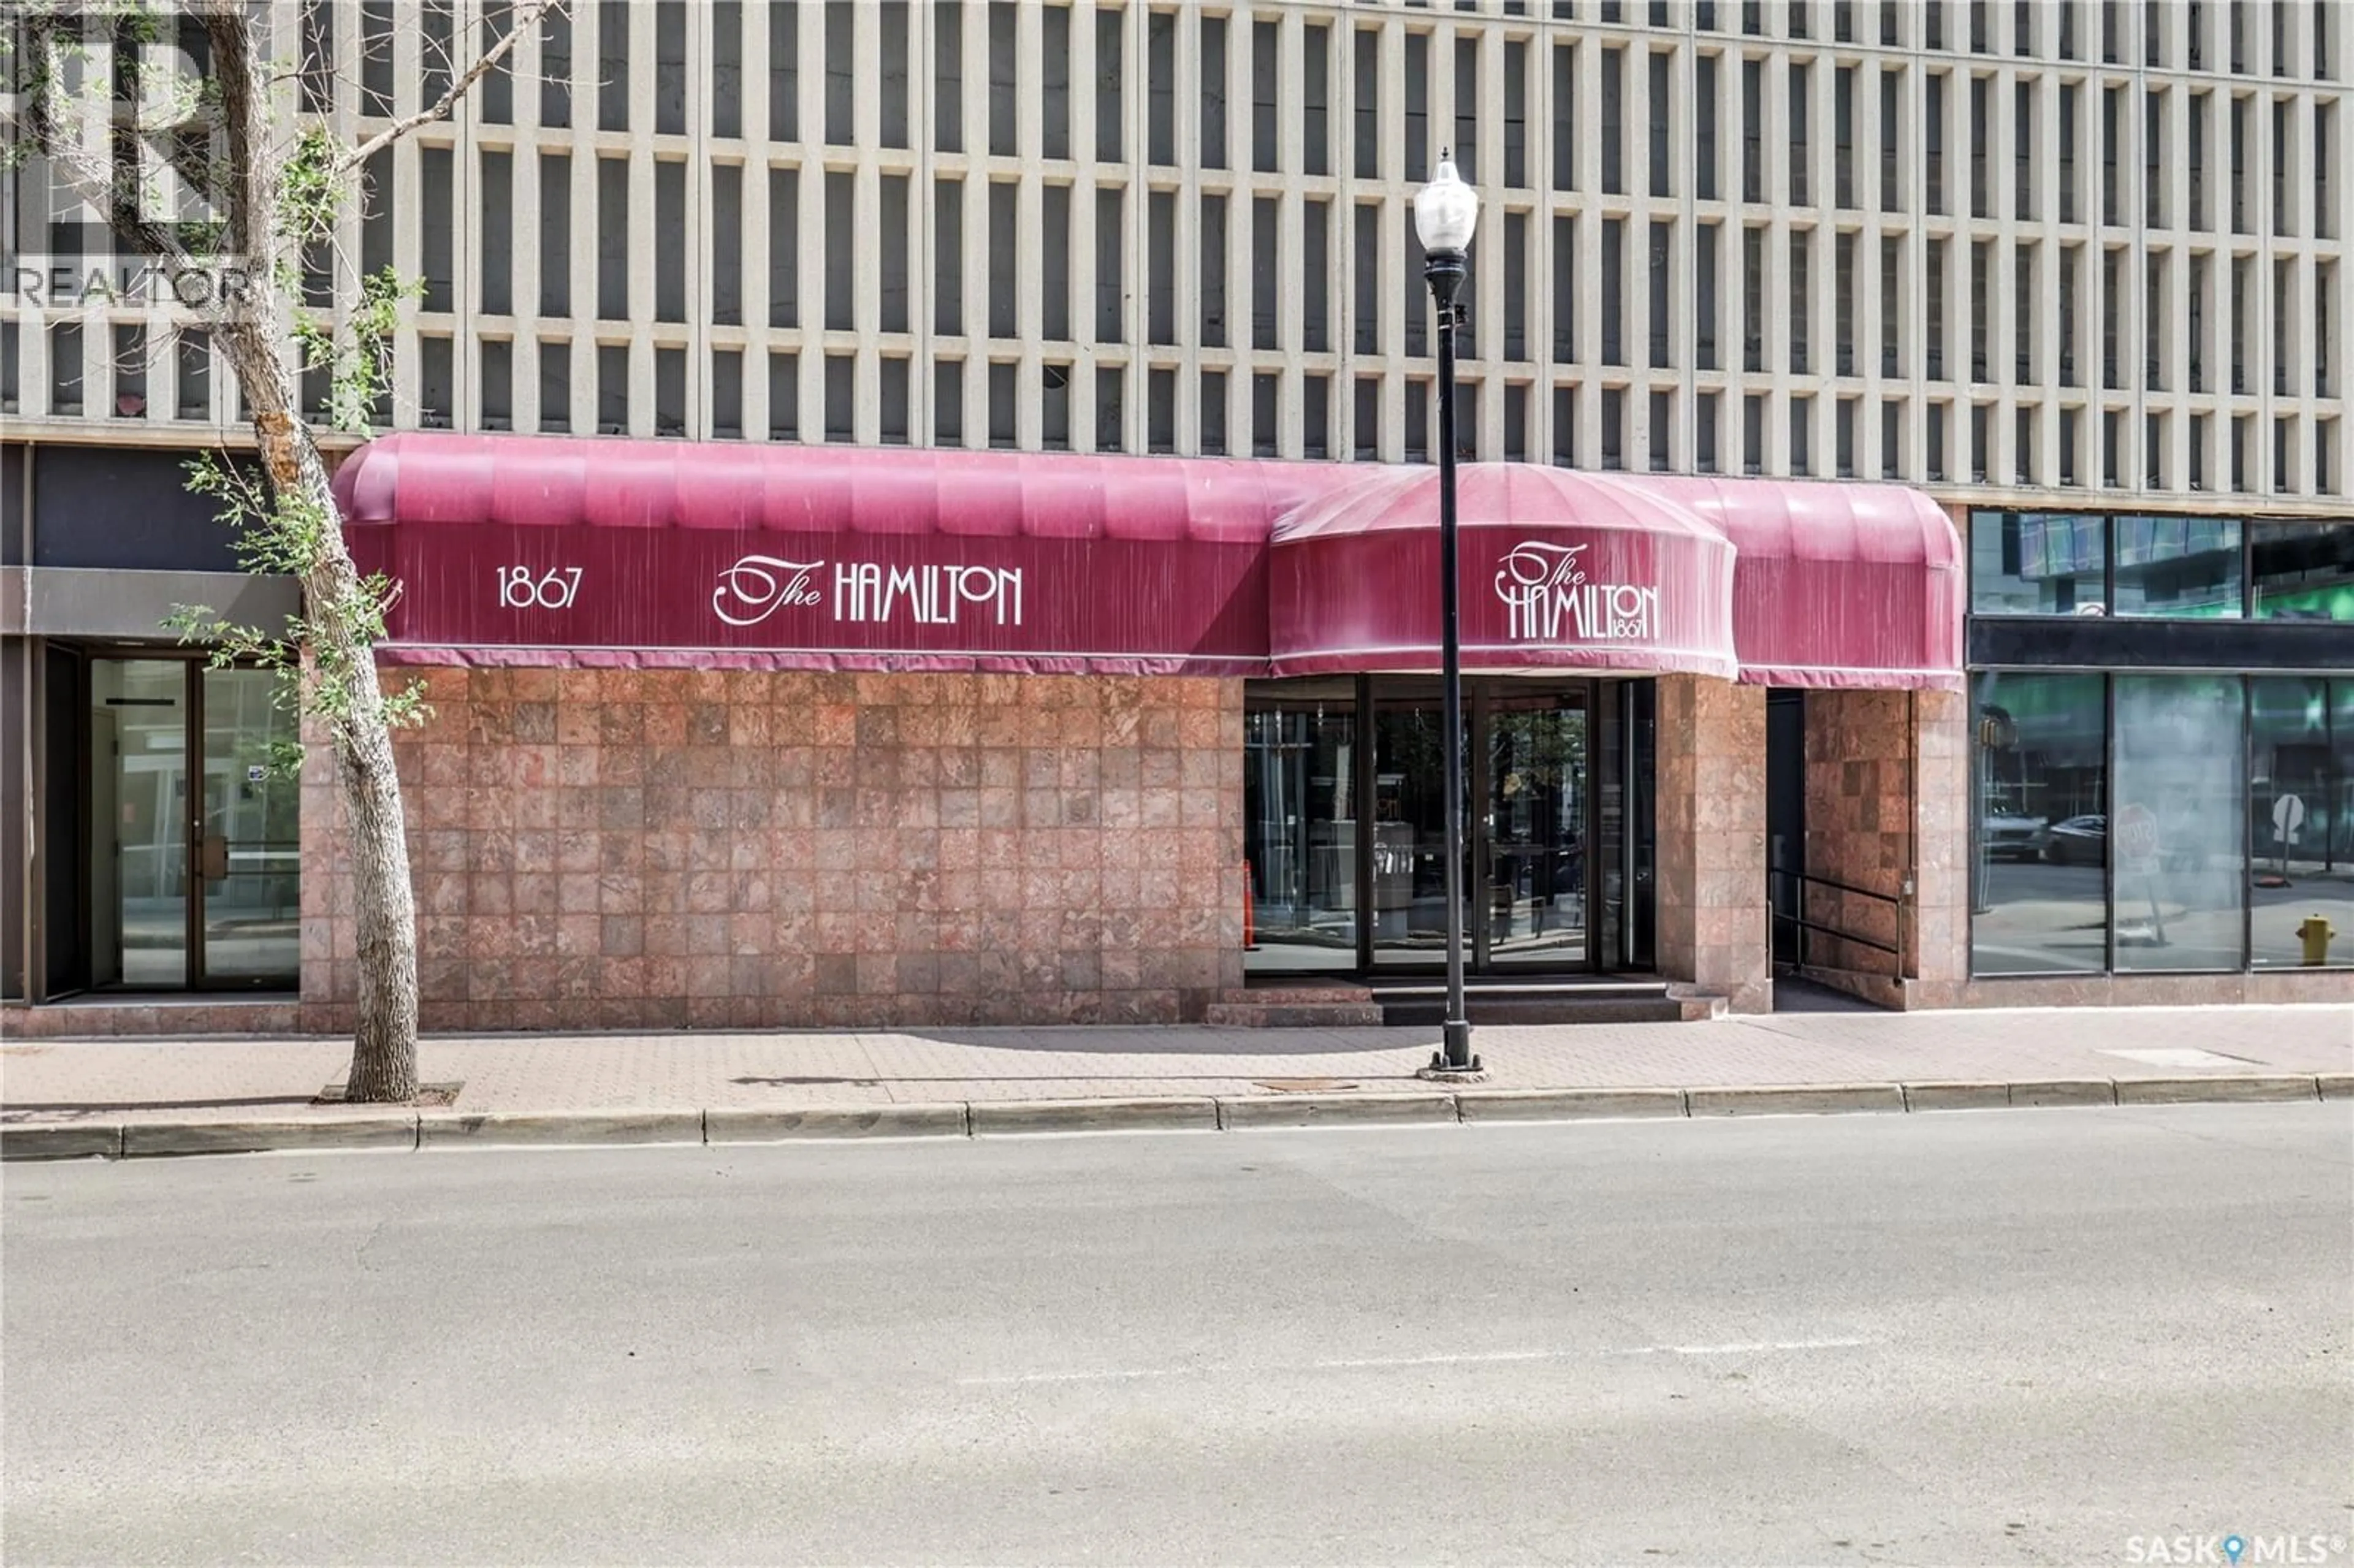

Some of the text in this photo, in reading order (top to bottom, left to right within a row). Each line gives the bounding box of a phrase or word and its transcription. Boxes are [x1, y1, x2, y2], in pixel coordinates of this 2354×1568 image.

[497, 566, 582, 609] 1867
[713, 554, 1023, 626] The HAMILTON
[1495, 541, 1588, 605] The
[1509, 585, 1658, 639] HAMILTON
[1613, 618, 1643, 638] 1867
